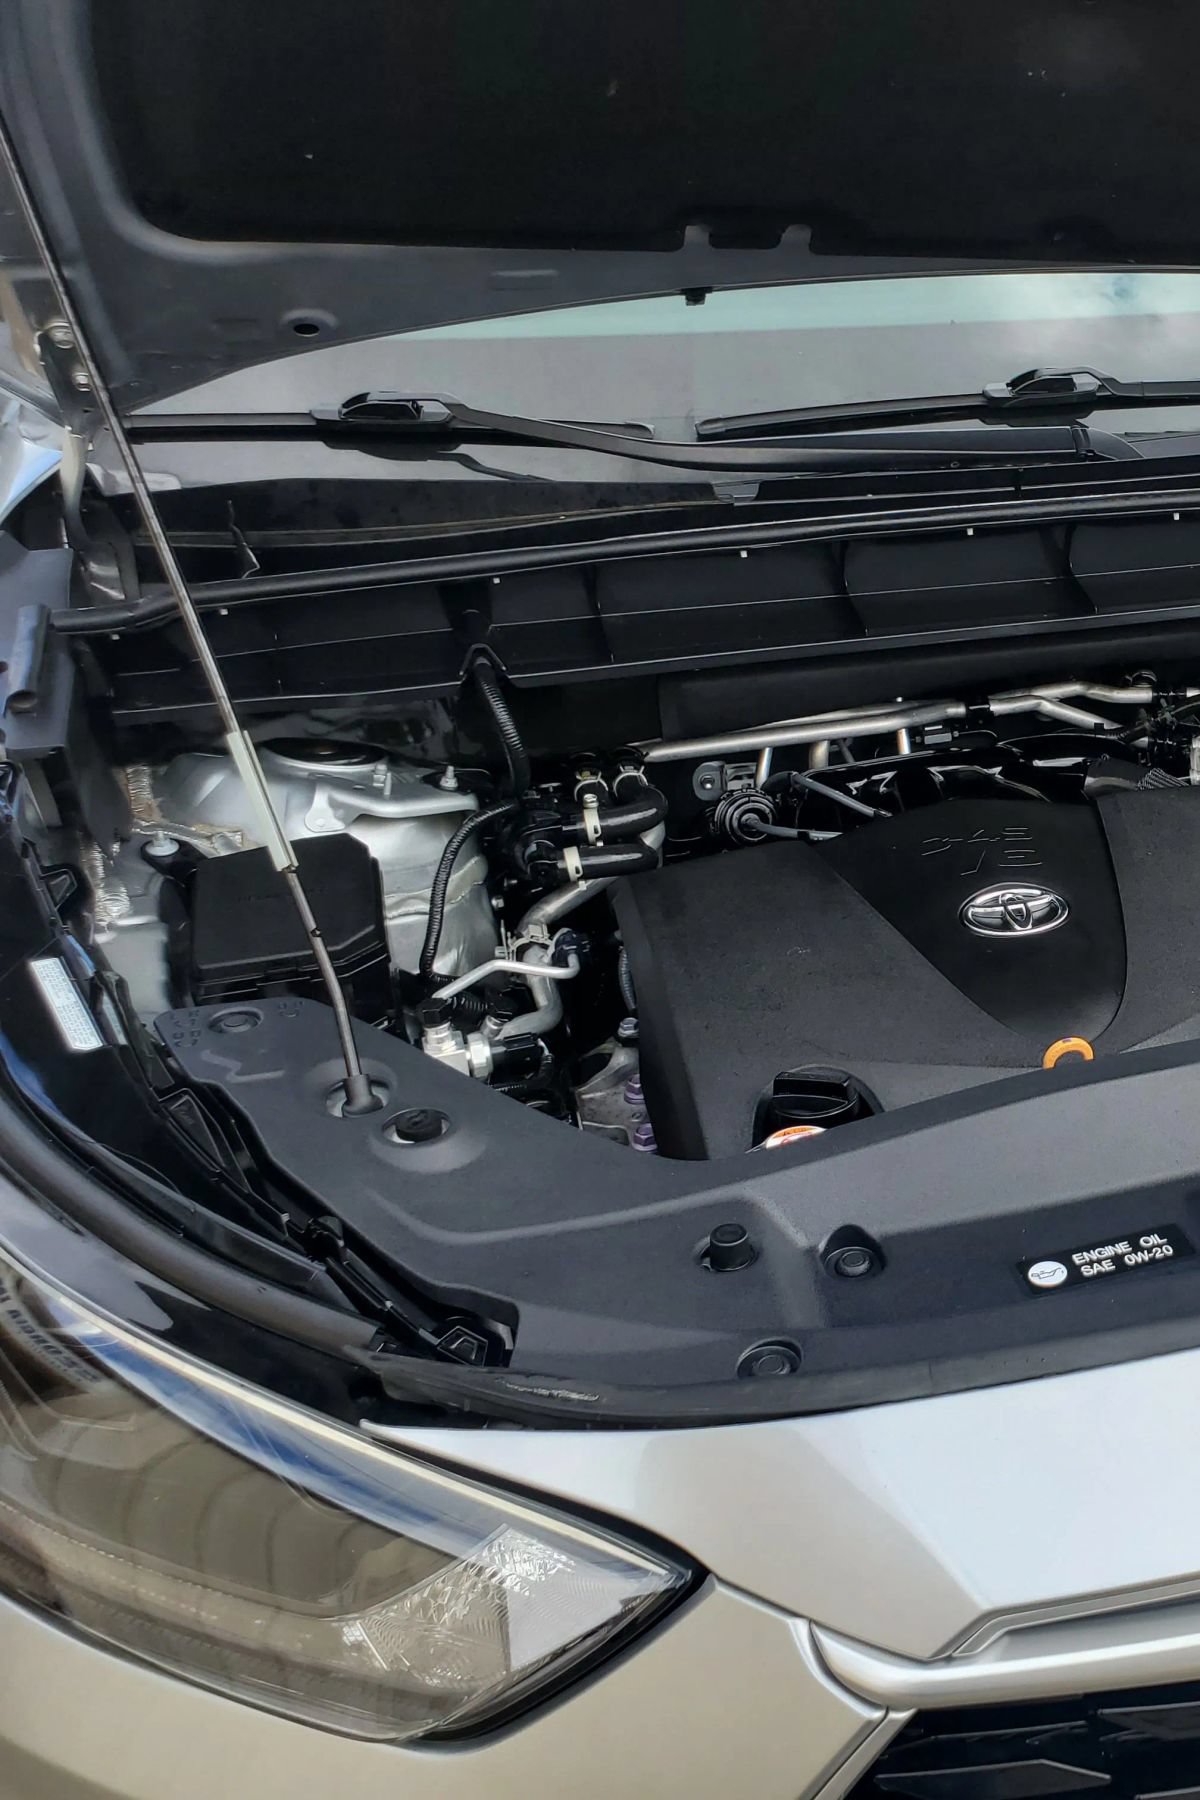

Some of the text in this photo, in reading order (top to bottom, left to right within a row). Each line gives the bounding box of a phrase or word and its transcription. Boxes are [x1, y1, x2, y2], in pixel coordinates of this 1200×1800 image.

[1072, 1233, 1168, 1264] ENGINE OIL
[1080, 1244, 1174, 1277] SAE 0W-20
